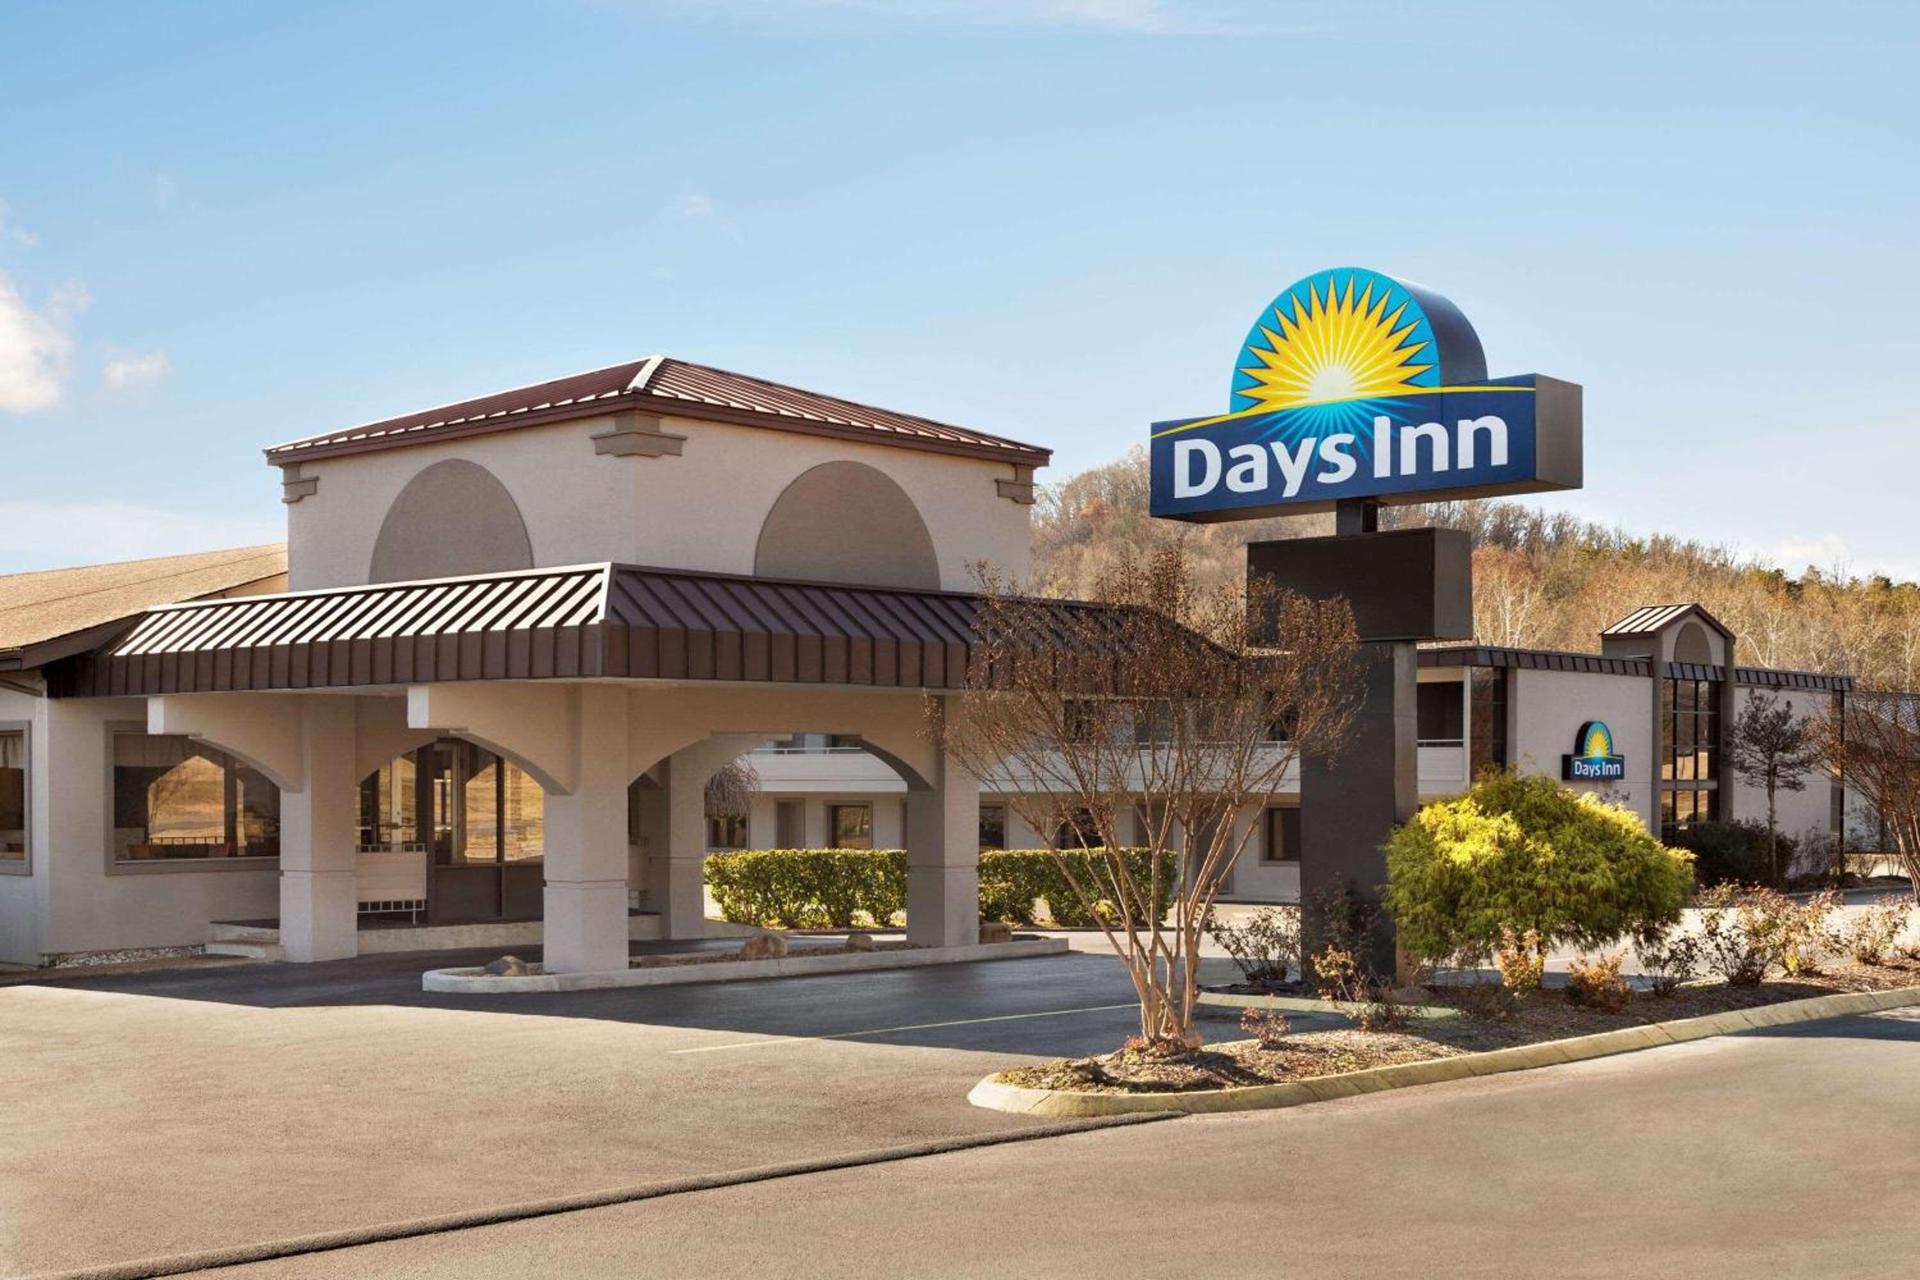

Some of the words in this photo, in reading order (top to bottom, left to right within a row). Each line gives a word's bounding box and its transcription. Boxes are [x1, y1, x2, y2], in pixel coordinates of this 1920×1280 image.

[1173, 433, 1357, 498] Days
[1373, 415, 1508, 479] Inn
[1575, 761, 1601, 777] Days
[1602, 761, 1621, 775] Inn
